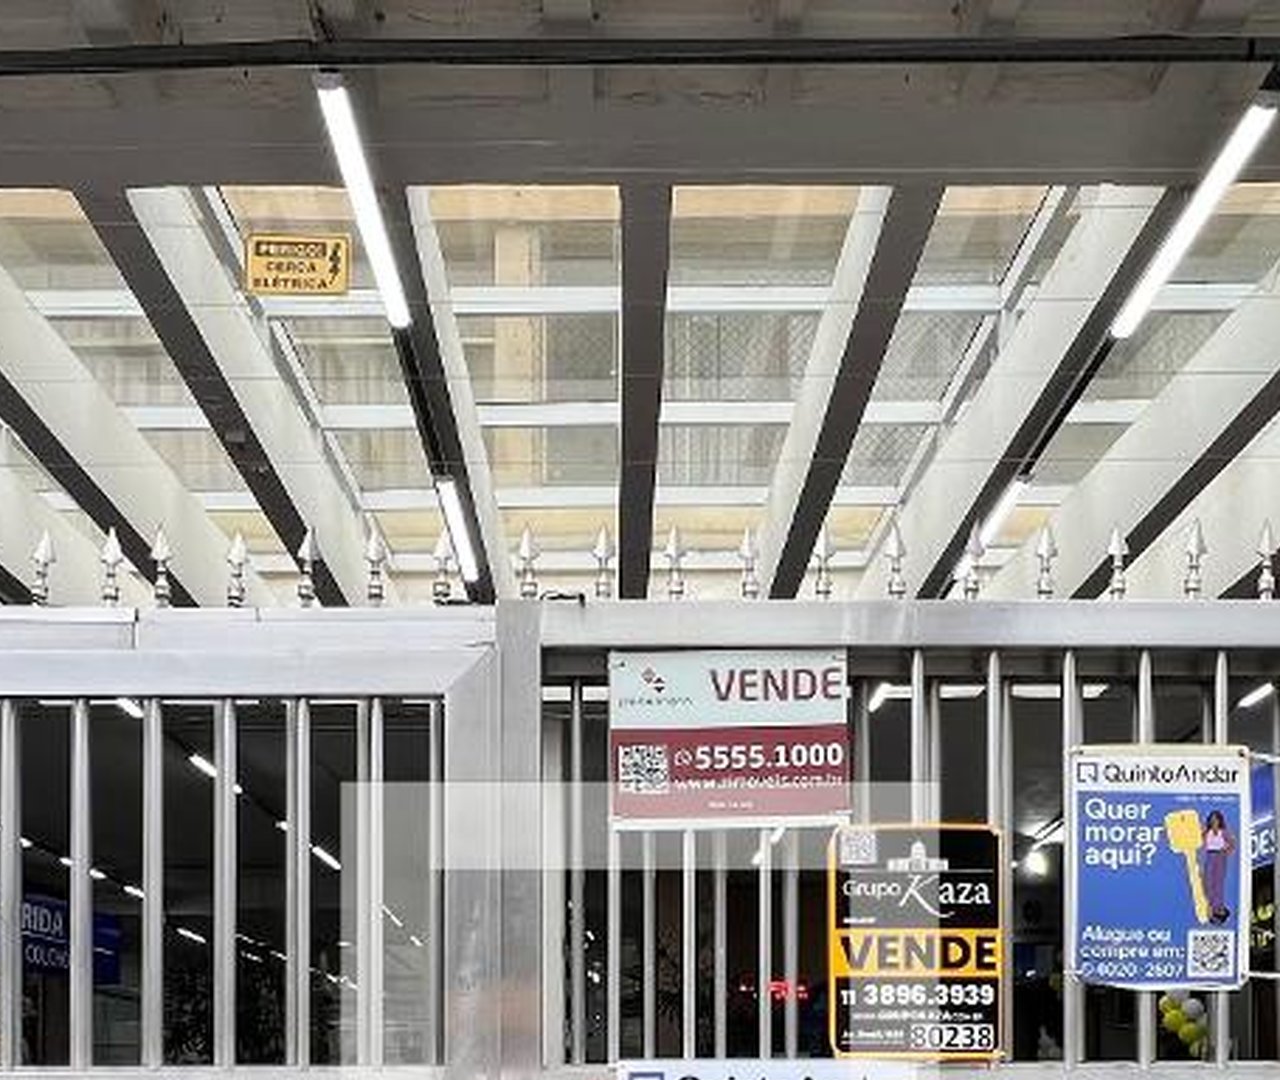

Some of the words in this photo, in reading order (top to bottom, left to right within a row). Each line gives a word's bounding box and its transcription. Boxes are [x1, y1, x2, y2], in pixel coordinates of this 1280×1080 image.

[266, 261, 317, 273] CERCA
[709, 667, 843, 702] VENDE
[695, 743, 844, 771] 5555.1000
[1104, 763, 1239, 784] QuintoAndar
[1084, 799, 1151, 820] Quer
[1085, 824, 1165, 842] morar
[1085, 844, 1157, 870] aqui?
[842, 880, 901, 900] Grupo
[840, 935, 998, 971] VENDE
[863, 984, 995, 1006] 3896.3939
